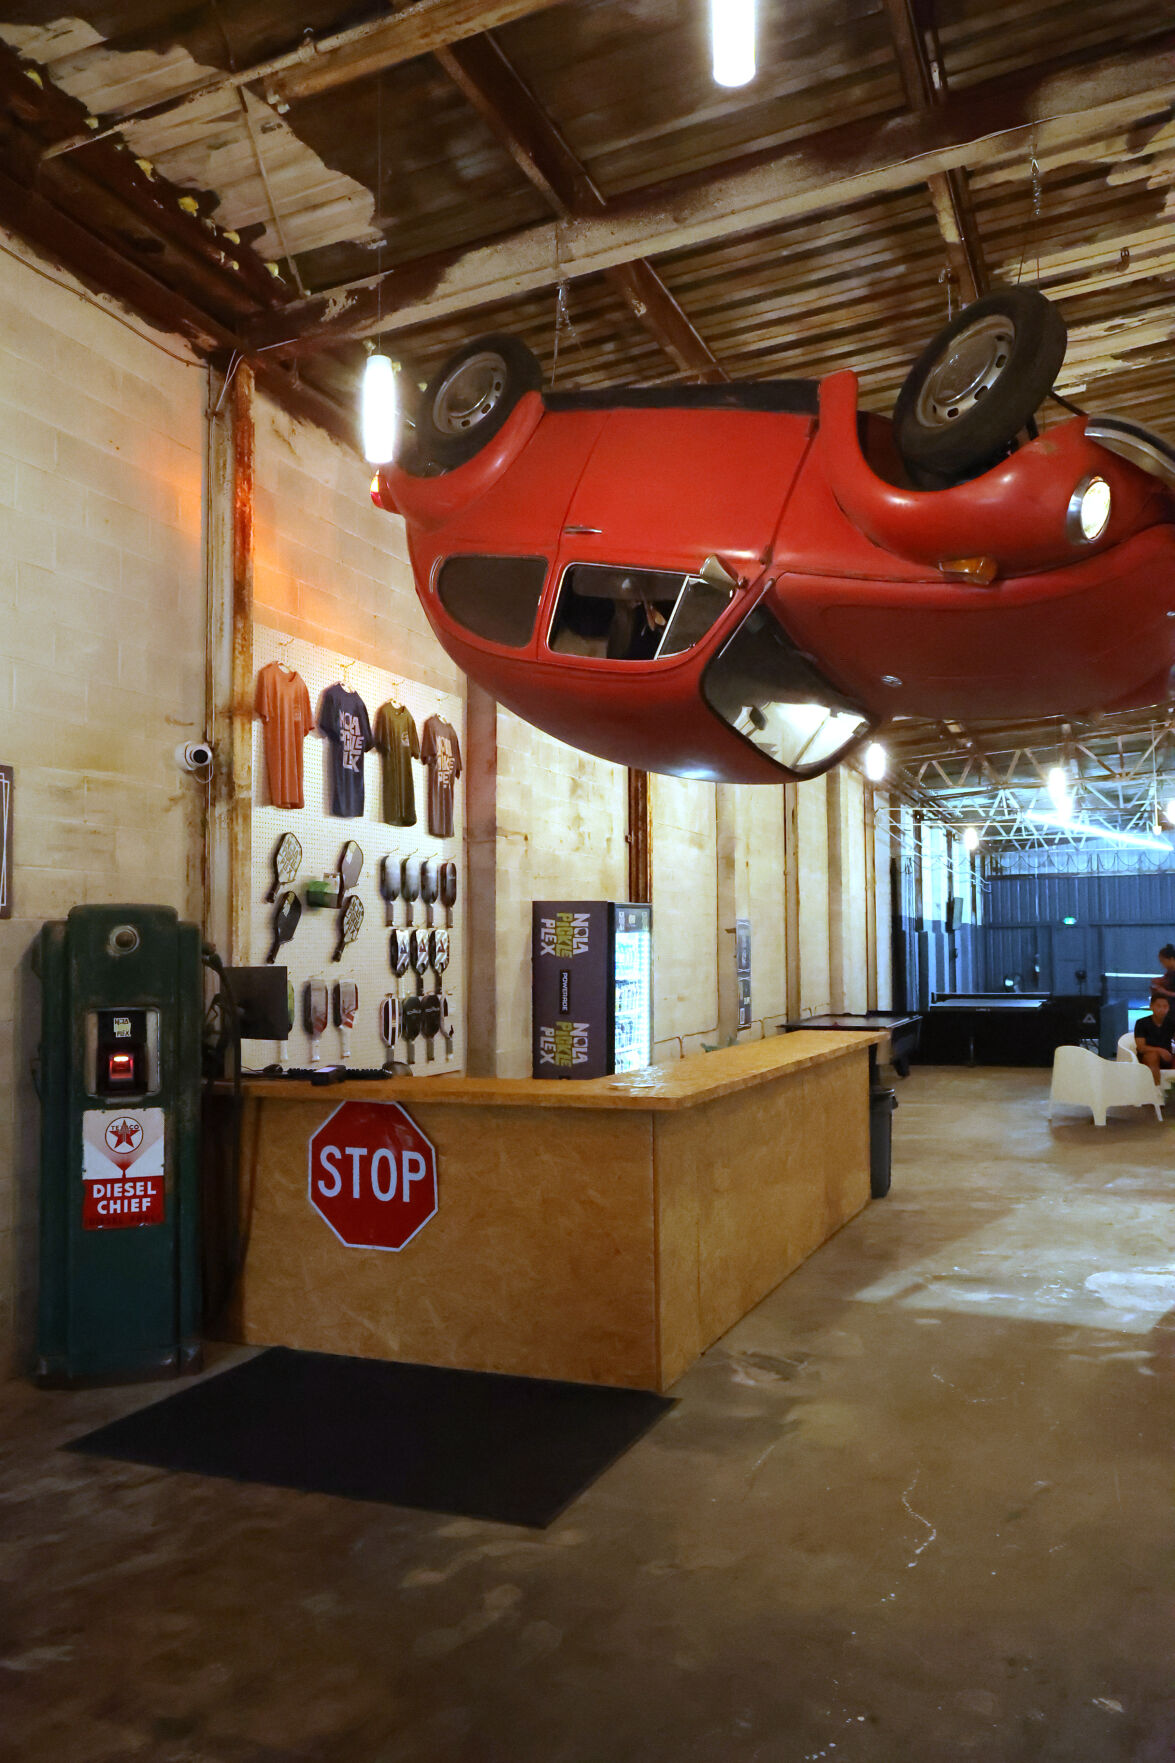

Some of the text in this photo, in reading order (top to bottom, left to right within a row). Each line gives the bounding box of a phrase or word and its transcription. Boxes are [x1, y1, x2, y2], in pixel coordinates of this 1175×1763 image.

[540, 918, 557, 956] PLEX
[556, 912, 573, 959] PICKLE
[570, 913, 591, 955] NOLA
[540, 1026, 557, 1065] PLEX
[555, 1021, 573, 1068] PICKLE
[569, 1022, 591, 1065] NOLA
[92, 1181, 157, 1199] DIESEL
[317, 1144, 427, 1203] STOP
[96, 1197, 152, 1215] CHIEF
